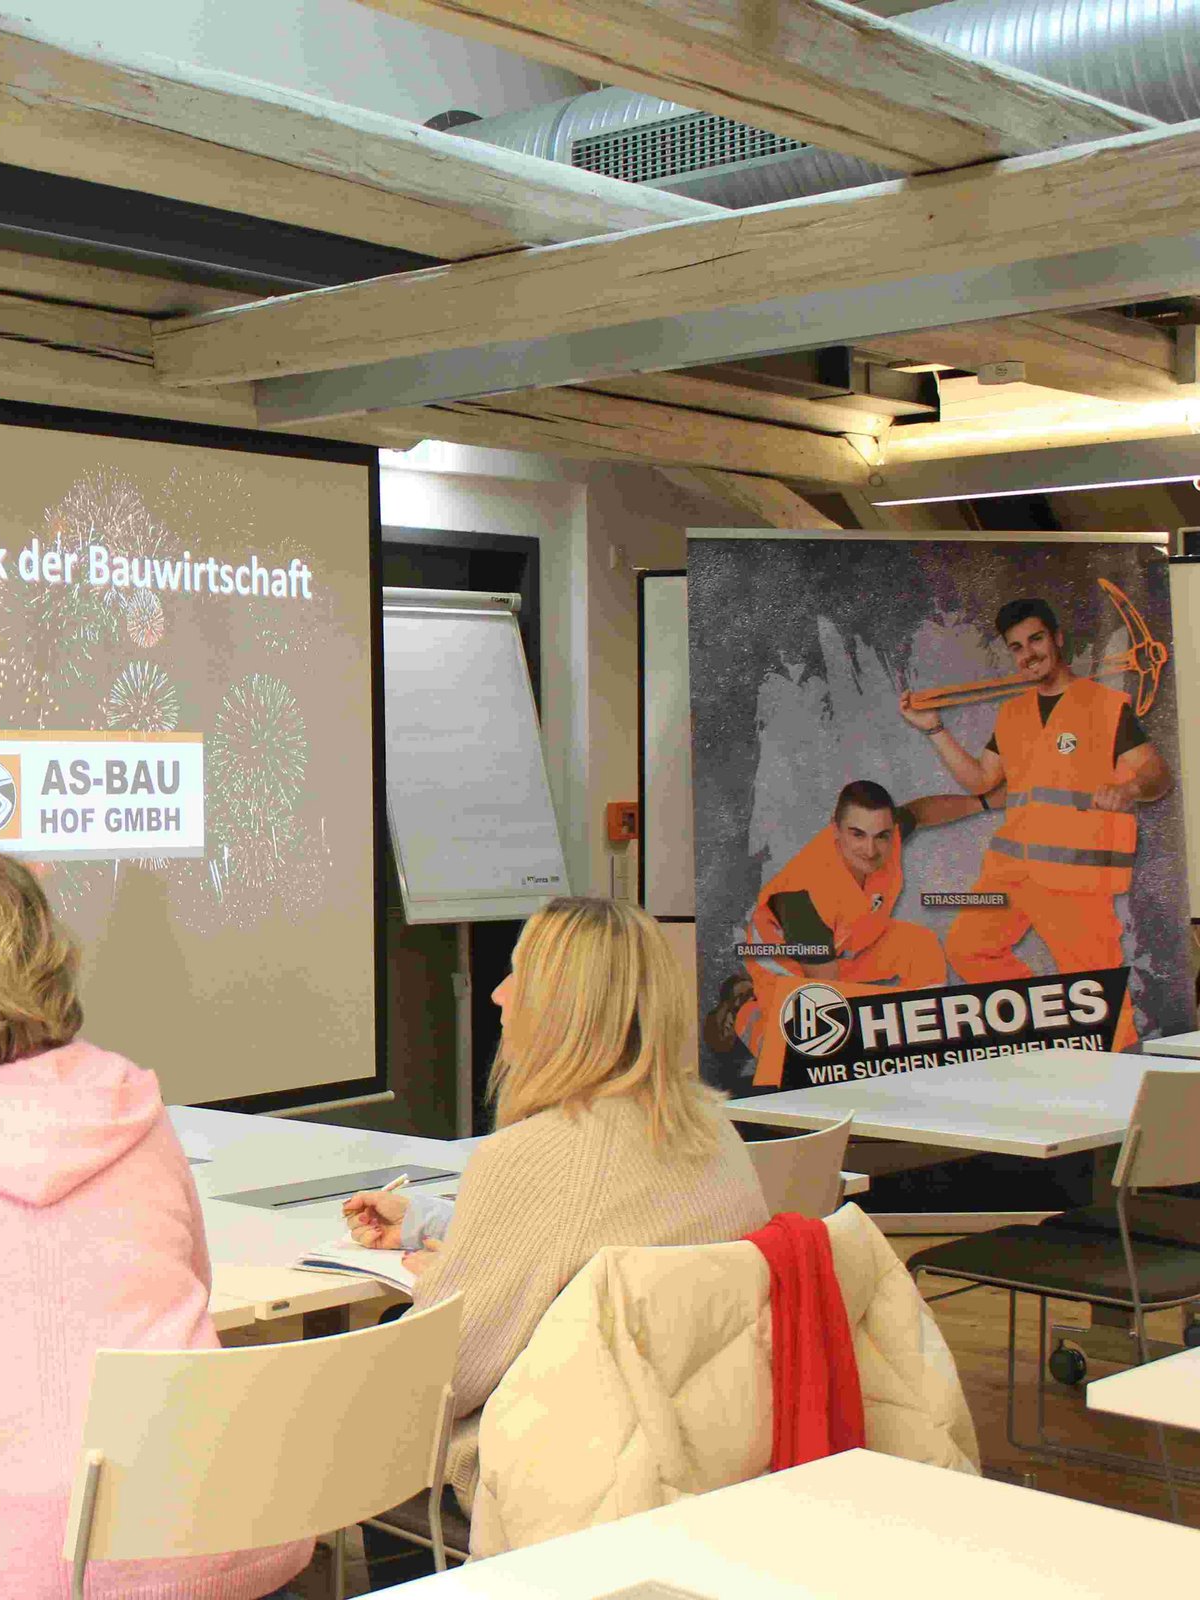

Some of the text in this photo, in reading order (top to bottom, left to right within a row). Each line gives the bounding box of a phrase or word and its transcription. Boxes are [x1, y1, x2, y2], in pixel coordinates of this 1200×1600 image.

[18, 538, 79, 584] der
[89, 545, 312, 599] Bauwirtschaft
[41, 759, 181, 796] AS-BAU
[40, 807, 181, 834] HOF GMBH
[923, 894, 1004, 905] STRASSENBAUER
[737, 943, 829, 956] BAUGERÄTEFÜHRER
[858, 979, 1109, 1051] HEROES
[807, 1064, 847, 1084] WIR
[853, 1053, 939, 1079] SUCHEN
